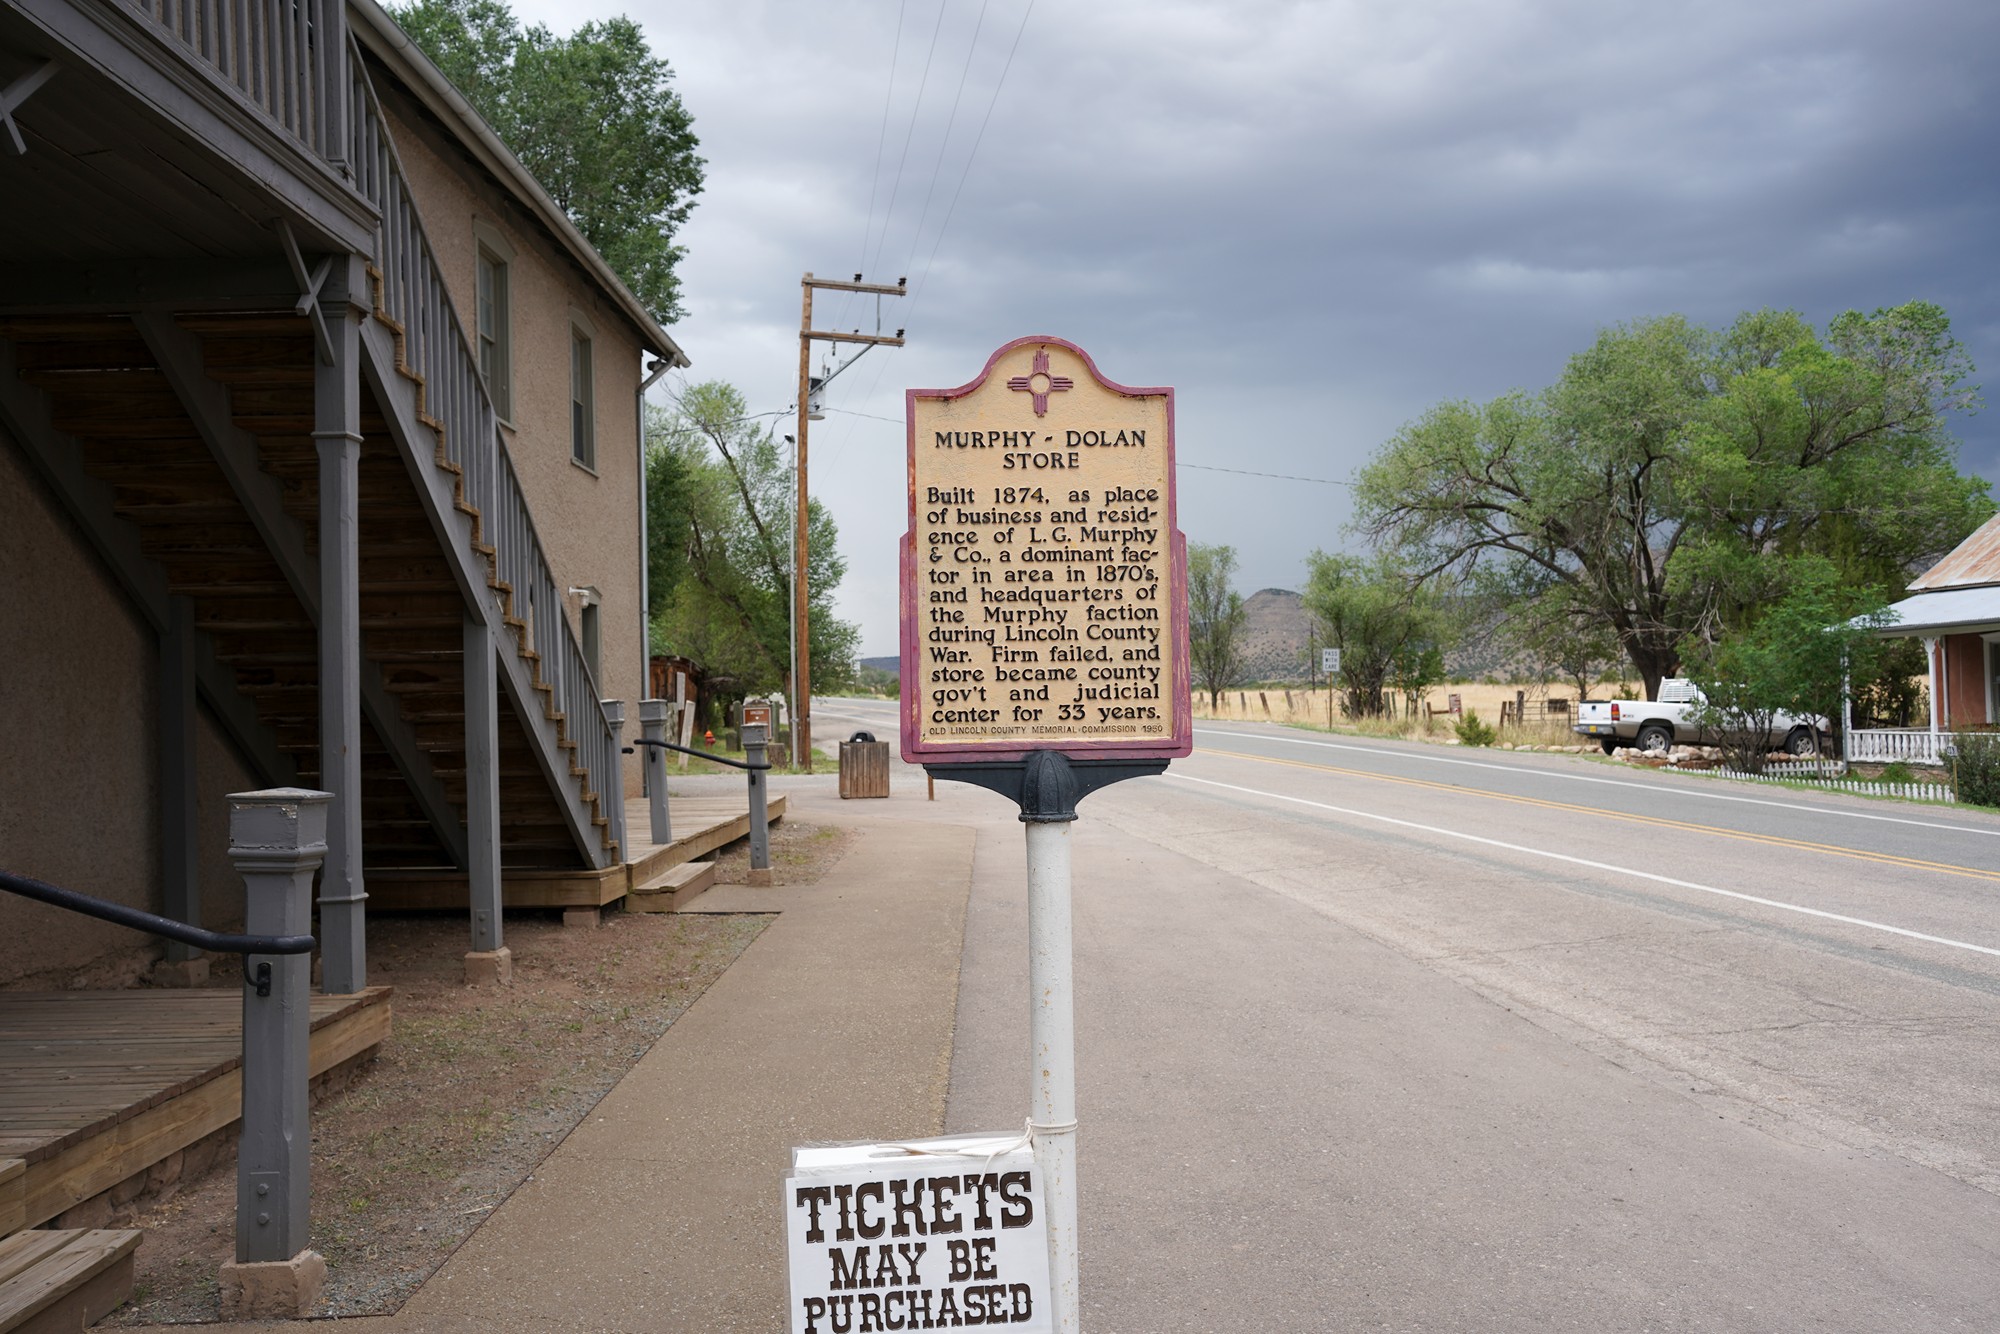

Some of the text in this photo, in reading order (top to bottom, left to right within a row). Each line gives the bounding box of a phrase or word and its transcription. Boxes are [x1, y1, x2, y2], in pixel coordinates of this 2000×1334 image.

[935, 432, 1035, 448] MURPHY
[1066, 430, 1146, 447] DOLAN
[1003, 453, 1079, 469] STORE
[927, 487, 1158, 505] Built 1874, as place
[927, 507, 1157, 524] of business and resid-
[929, 527, 1157, 545] ence of L. G. Murphy
[930, 547, 1158, 563] & Co., a dominant fac-
[929, 565, 1158, 584] tor in area in 1870's,
[930, 585, 1157, 605] and headquarters of
[930, 604, 1158, 625] the Murphy faction
[929, 625, 1160, 645] during Lincoln County
[930, 645, 1160, 662] War. Firm failed, and
[932, 664, 1160, 682] store became county
[933, 683, 1159, 706] gov't and judicial
[932, 705, 1161, 723] center for 33 years.
[930, 727, 946, 735] OLD
[951, 727, 987, 735] LINCOLN
[991, 726, 1026, 734] COUNTY
[1032, 726, 1076, 734] MEMORIAL
[1082, 725, 1136, 733] COMMISSION
[796, 1171, 1033, 1244] TICKETS
[829, 1237, 997, 1290] MAY BE
[803, 1283, 1033, 1334] PURCHASED
